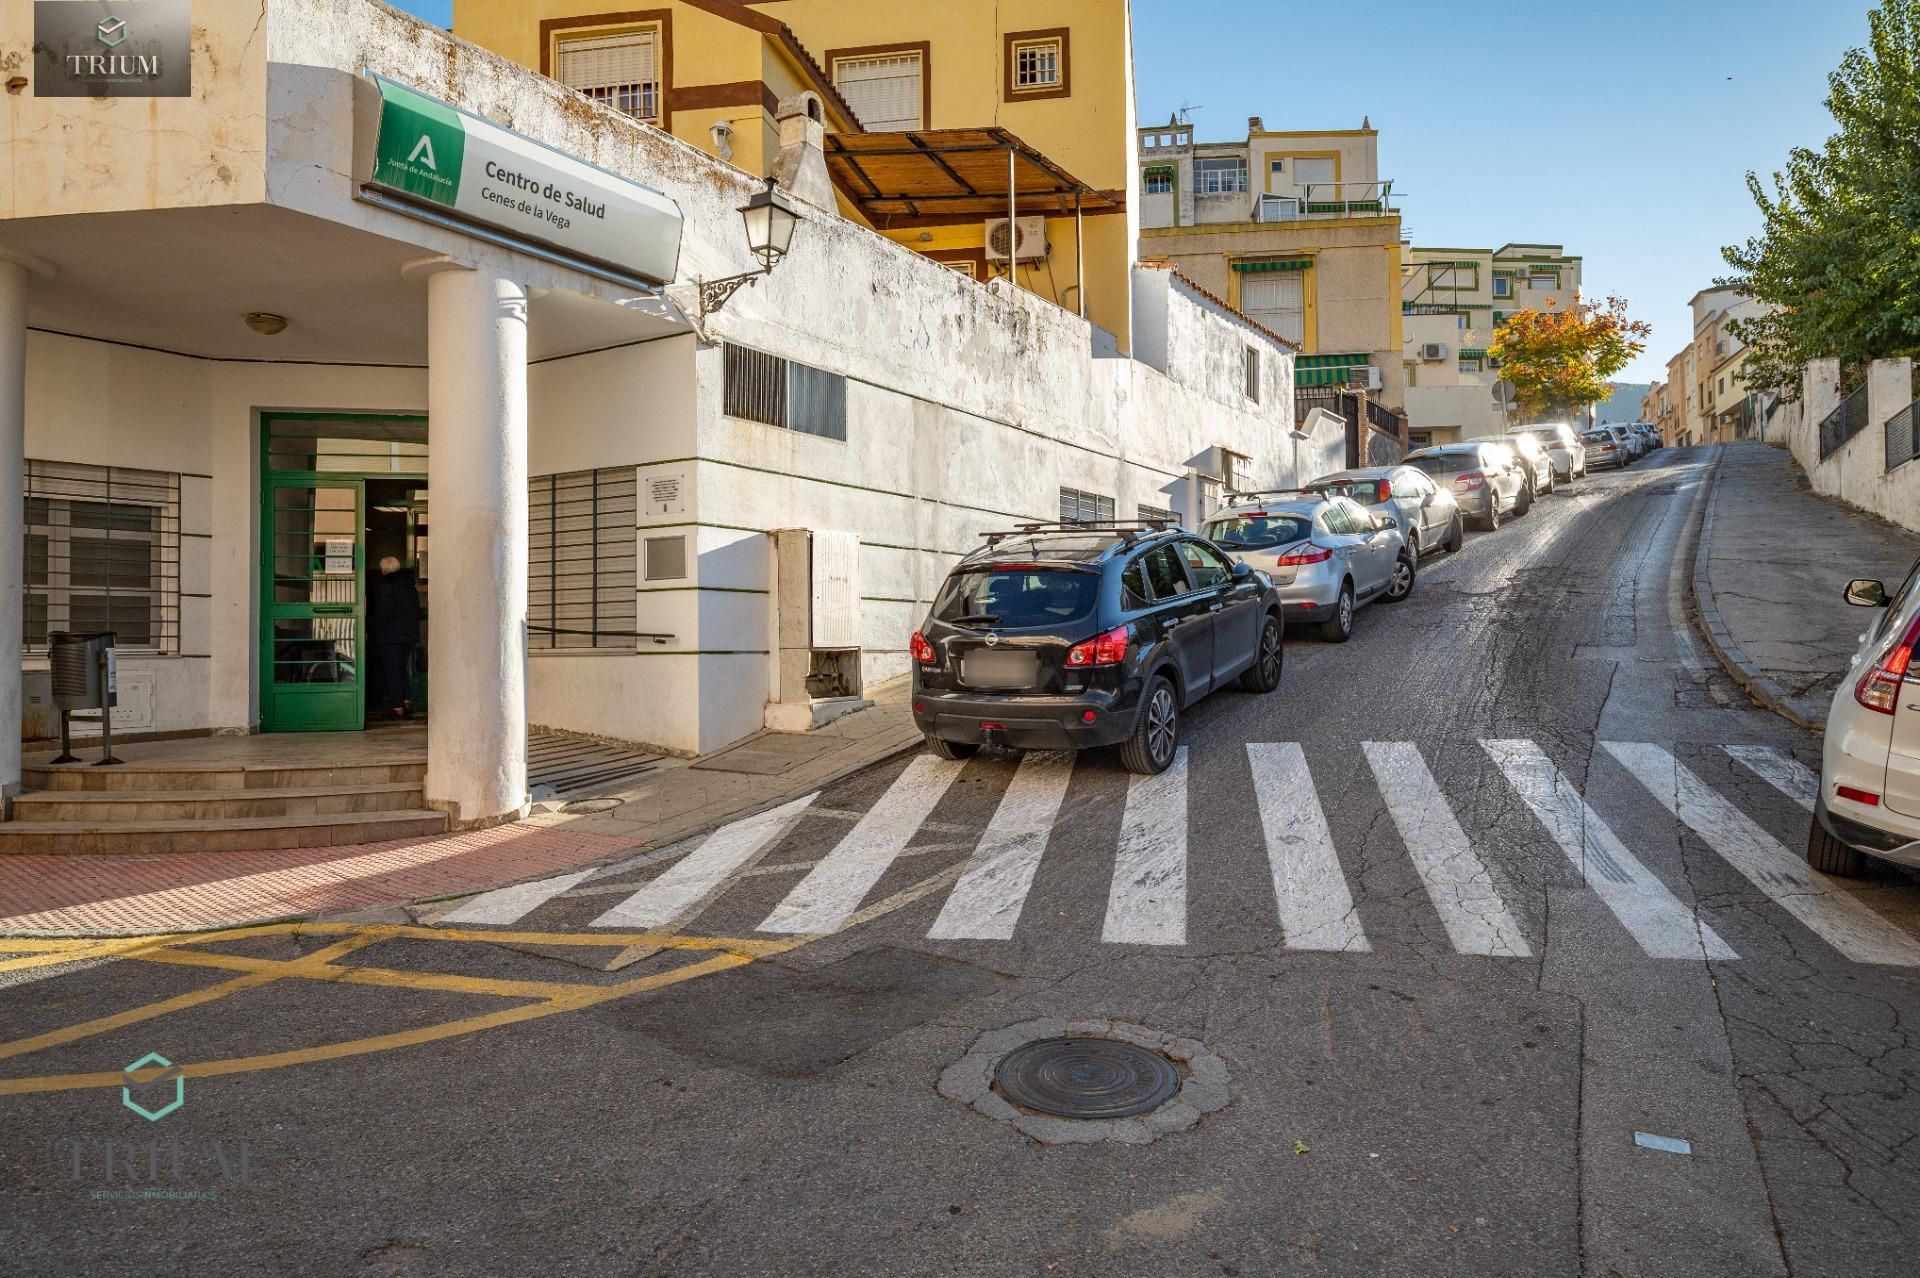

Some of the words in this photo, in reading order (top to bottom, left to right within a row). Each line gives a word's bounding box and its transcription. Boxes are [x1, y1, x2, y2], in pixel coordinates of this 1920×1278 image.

[387, 158, 408, 171] Junta
[409, 166, 419, 174] de
[419, 169, 453, 186] Andalucía
[485, 161, 540, 194] Centro
[543, 183, 562, 202] de
[565, 191, 606, 219] Salud
[481, 187, 516, 209] Cenes
[517, 200, 532, 215] de
[533, 204, 543, 219] la
[546, 209, 570, 229] Vega
